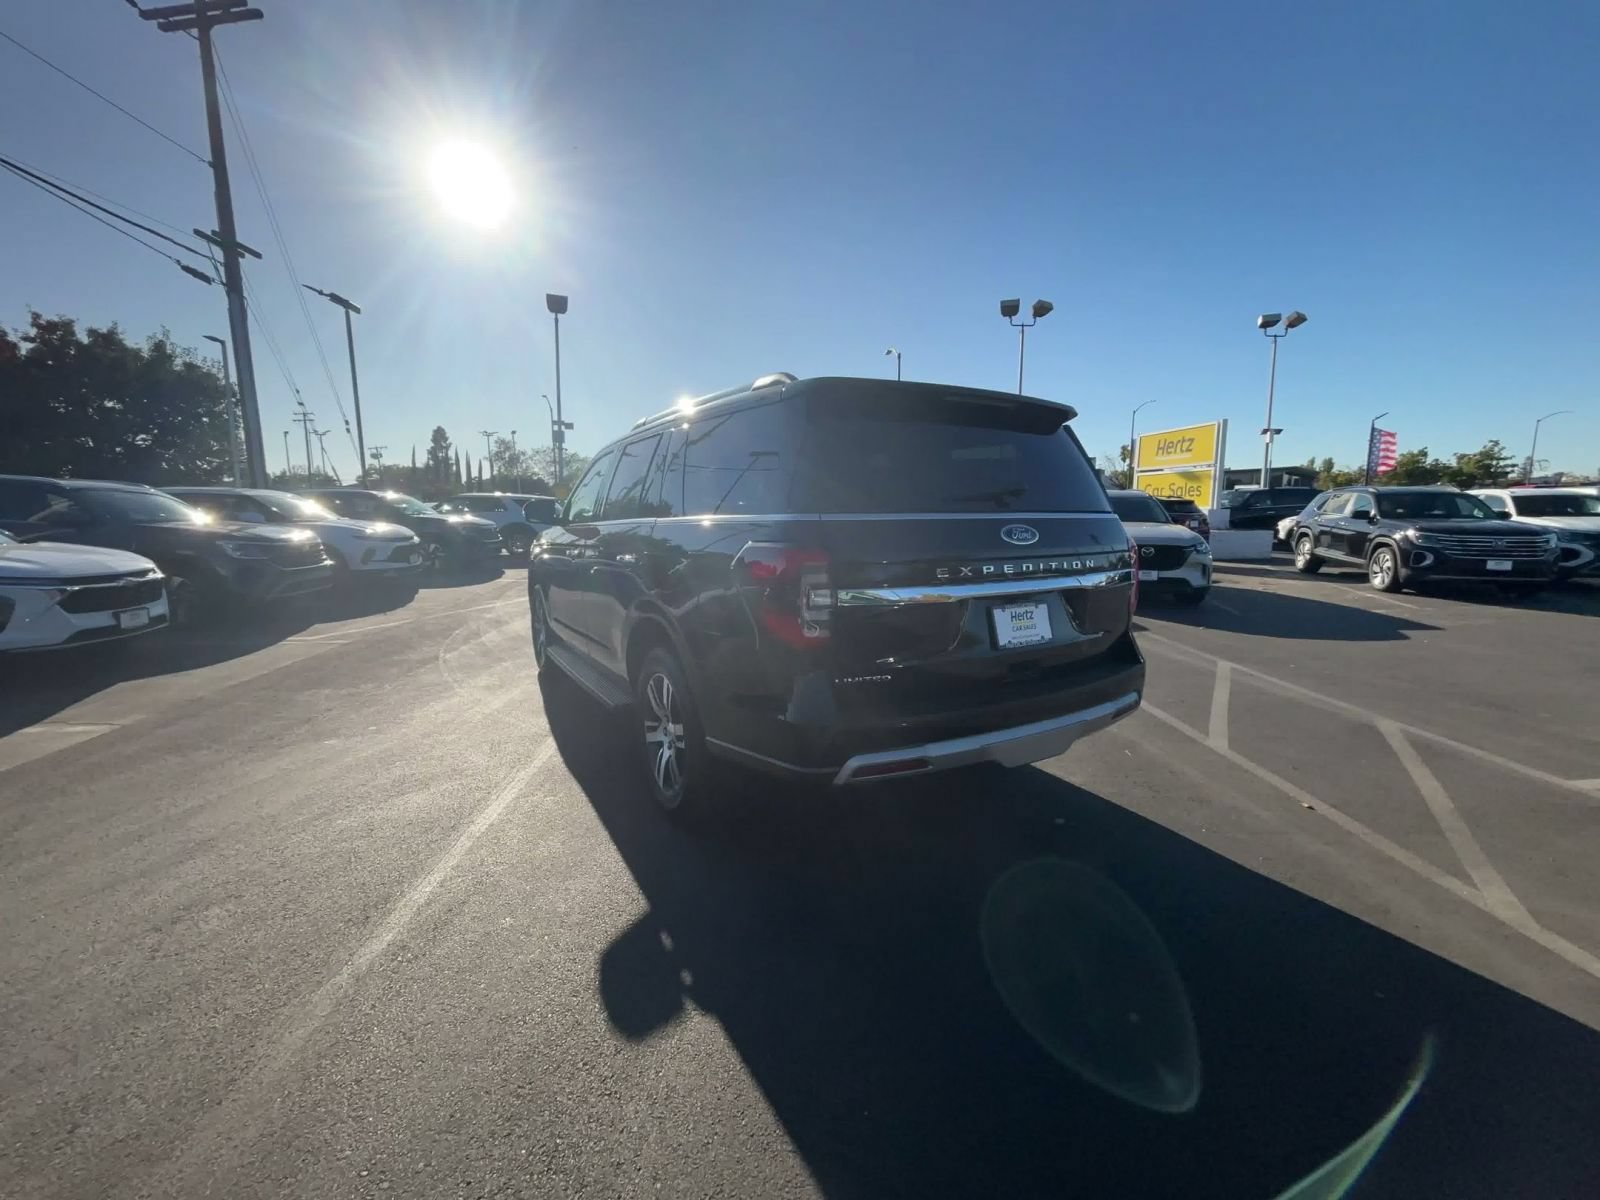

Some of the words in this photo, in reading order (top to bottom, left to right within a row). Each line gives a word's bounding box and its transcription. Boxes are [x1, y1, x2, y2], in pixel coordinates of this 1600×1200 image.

[1155, 436, 1195, 456] Hertz
[1144, 484, 1166, 497] Car
[1168, 481, 1202, 497] Sales
[936, 559, 1095, 578] EXPEDITION
[1010, 609, 1035, 622] Hertz
[1012, 625, 1023, 633] CAR
[1023, 624, 1037, 632] SALES
